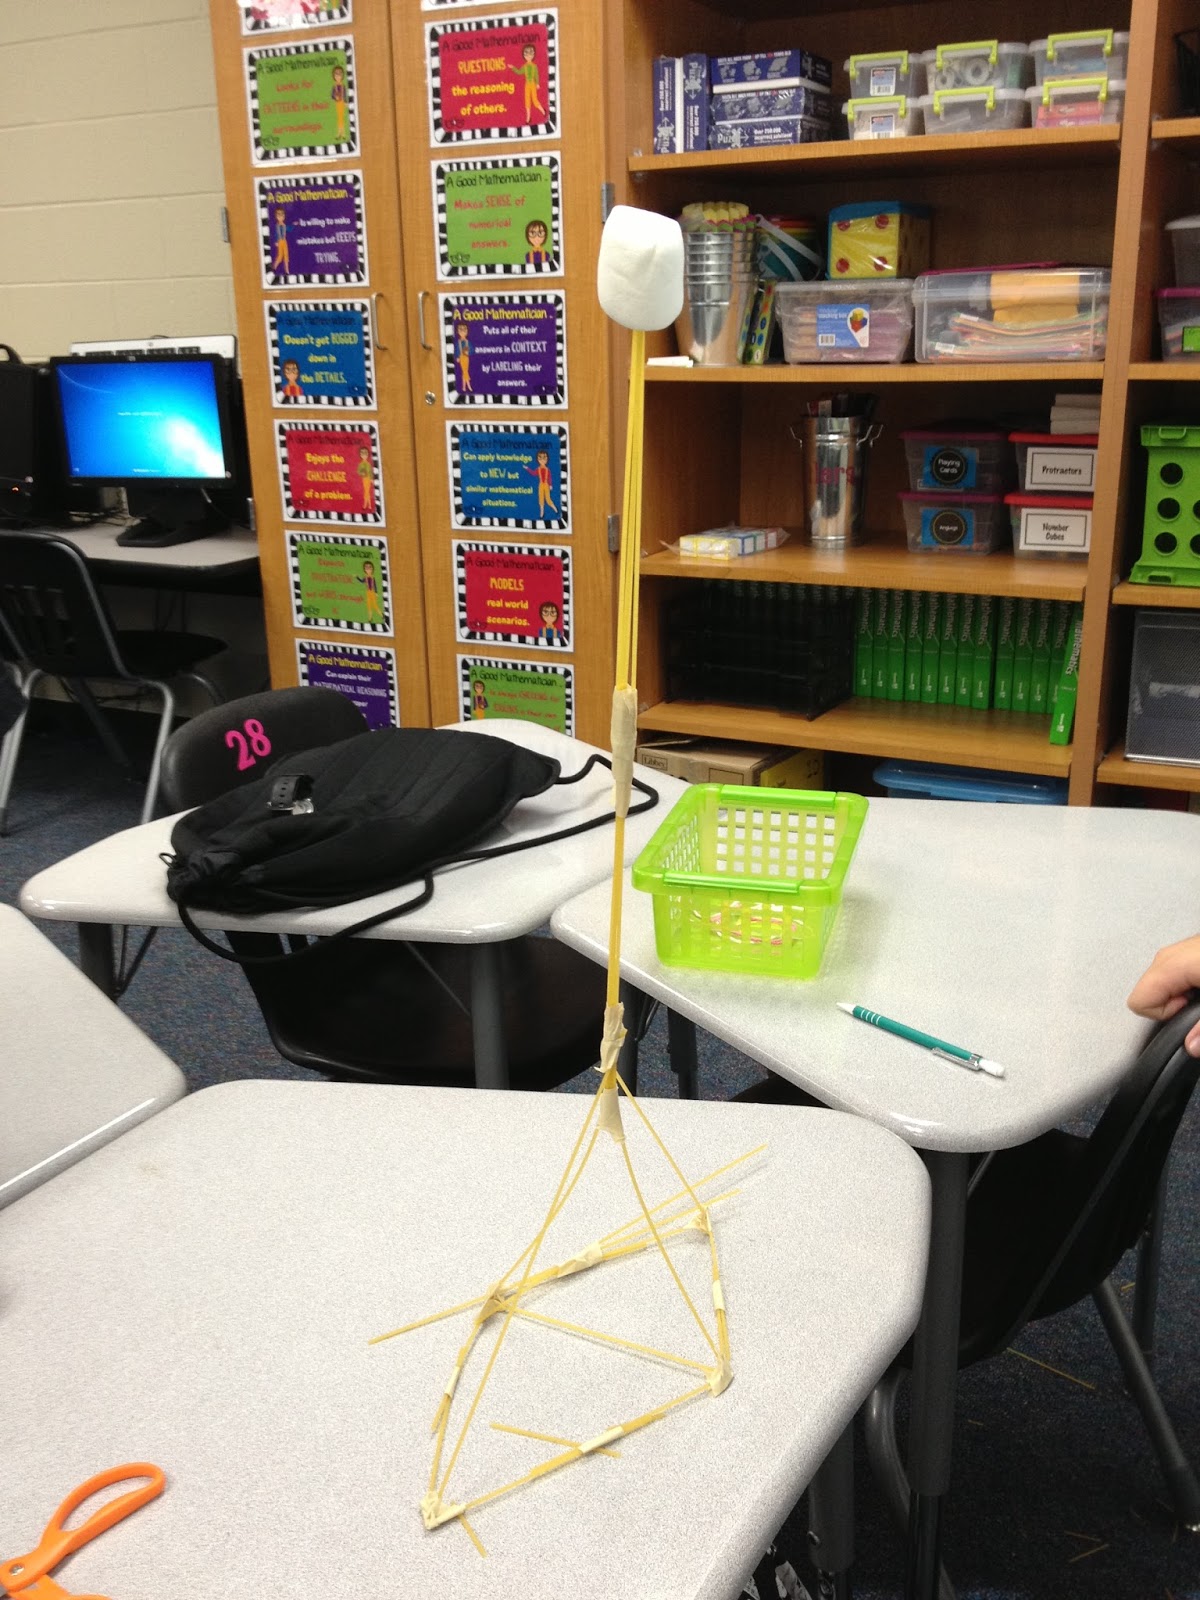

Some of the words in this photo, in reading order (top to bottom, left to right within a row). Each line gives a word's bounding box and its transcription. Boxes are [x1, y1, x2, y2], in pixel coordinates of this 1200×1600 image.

[453, 39, 473, 51] Good
[458, 57, 506, 74] QUESTIONS
[452, 84, 468, 96] the
[470, 81, 515, 95] reasoning
[461, 103, 472, 116] of
[473, 103, 507, 115] others.
[446, 176, 454, 188] A
[456, 175, 477, 187] Good
[479, 171, 542, 185] Mathematician
[266, 192, 275, 203] A
[276, 192, 294, 203] Good
[295, 189, 348, 201] Mathematician
[454, 200, 483, 210] Makes
[514, 195, 526, 206] of
[334, 217, 351, 225] make
[325, 235, 336, 243] but
[453, 309, 461, 320] A
[463, 309, 483, 320] Good
[485, 307, 547, 320] Mathematician
[483, 325, 499, 335] Puts
[501, 325, 509, 334] all
[510, 325, 519, 334] of
[519, 326, 538, 334] their
[315, 336, 330, 348] get
[474, 346, 503, 354] answers
[511, 341, 547, 353] CONTEXT
[307, 353, 329, 363] down
[482, 364, 491, 374] by
[491, 361, 523, 372] LABELING
[524, 364, 543, 372] their
[300, 373, 315, 383] the
[497, 379, 528, 387] answers.
[331, 453, 345, 464] the
[463, 452, 477, 461] Can
[477, 452, 496, 463] apply
[496, 453, 532, 464] knowledge
[938, 458, 961, 468] Playing
[480, 470, 488, 478] to
[488, 467, 507, 479] NEW
[507, 471, 520, 480] but
[1041, 465, 1082, 476] Protractors
[304, 488, 314, 499] of
[320, 490, 353, 501] problem.
[466, 485, 488, 493] similar
[489, 486, 534, 495] mathematical
[482, 498, 518, 508] situations.
[1043, 523, 1069, 533] Number
[1045, 531, 1065, 541] Cubes
[306, 546, 322, 556] Good
[323, 547, 373, 559] Mathematician
[475, 558, 495, 568] Good
[489, 577, 525, 592] MODELS
[487, 599, 504, 608] real
[504, 600, 529, 610] world
[486, 615, 531, 627] scenarios.
[308, 654, 315, 663] A
[317, 655, 333, 666] Good
[334, 657, 383, 671] Mathematician
[325, 670, 337, 678] Can
[471, 669, 478, 679] A
[480, 671, 498, 681] Good
[500, 673, 557, 687] Mathematician
[225, 718, 272, 771] 28
